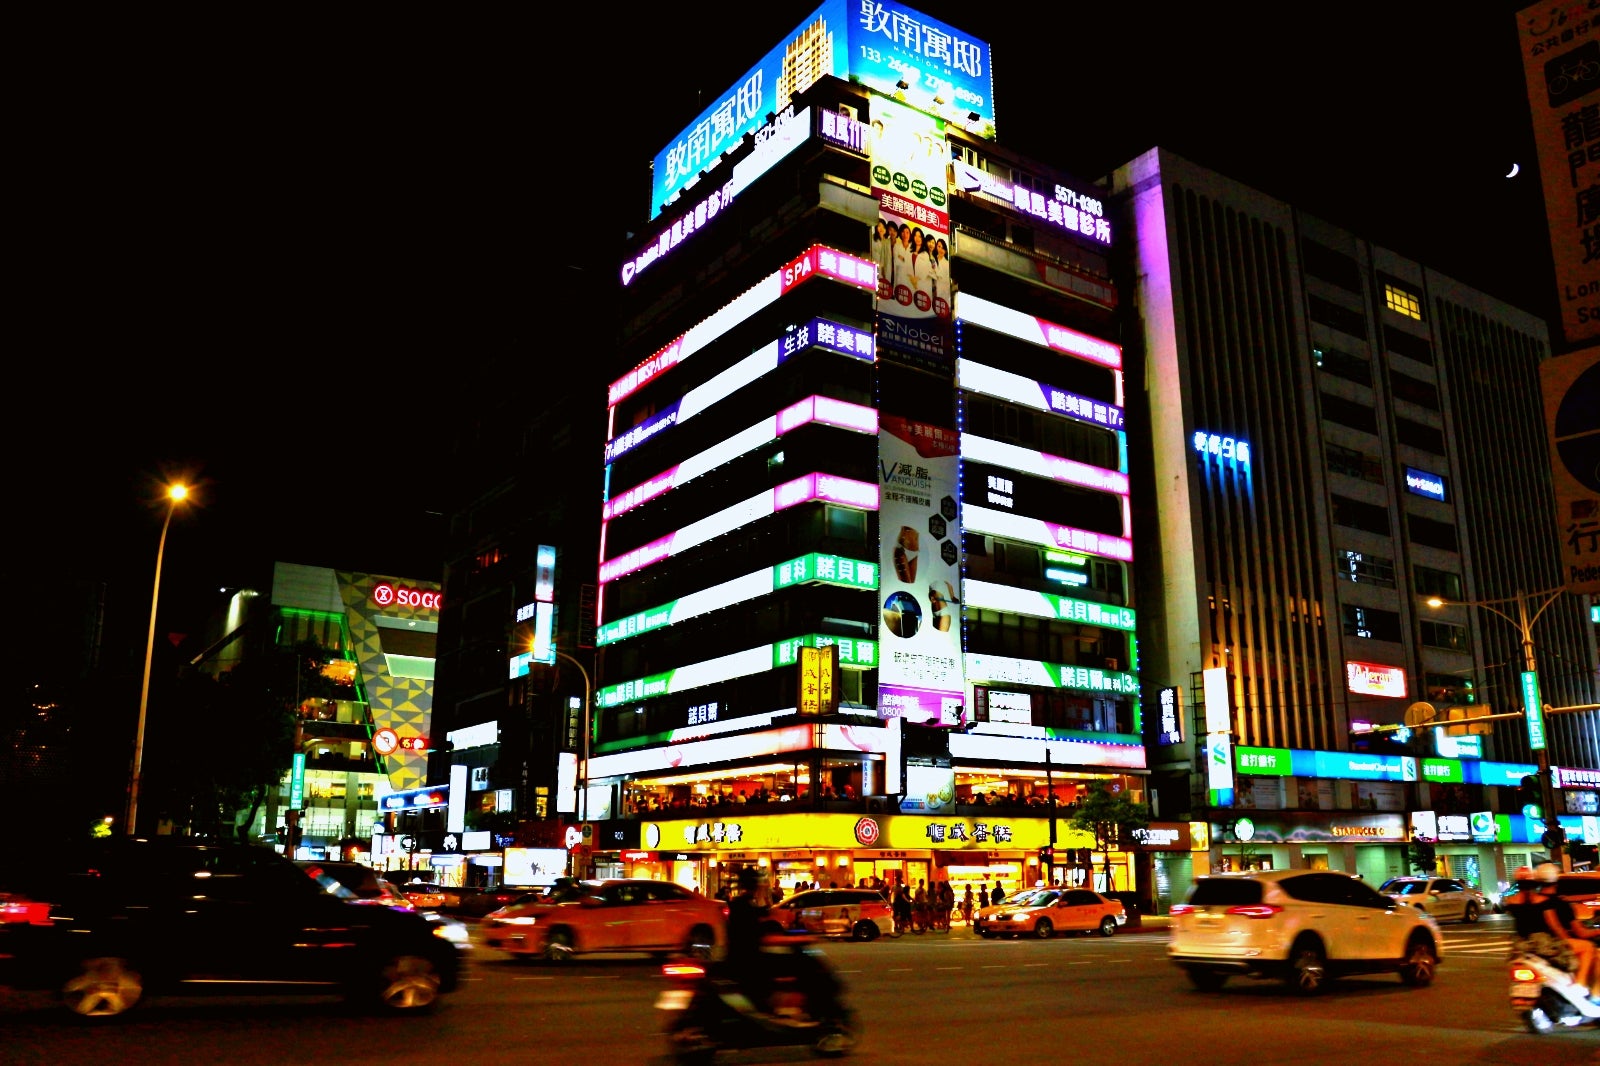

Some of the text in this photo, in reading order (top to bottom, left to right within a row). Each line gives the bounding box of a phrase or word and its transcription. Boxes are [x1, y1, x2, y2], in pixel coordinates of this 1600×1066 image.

[860, 0, 982, 77] 敦南寓邸
[1531, 14, 1600, 57] 公共自行
[664, 68, 763, 191] 敦南寓邸
[785, 256, 812, 286] SPA
[784, 326, 809, 356] 生技
[880, 459, 931, 490] VANQUISH
[779, 557, 807, 585] 眼科
[816, 556, 875, 585] 諾貝爾
